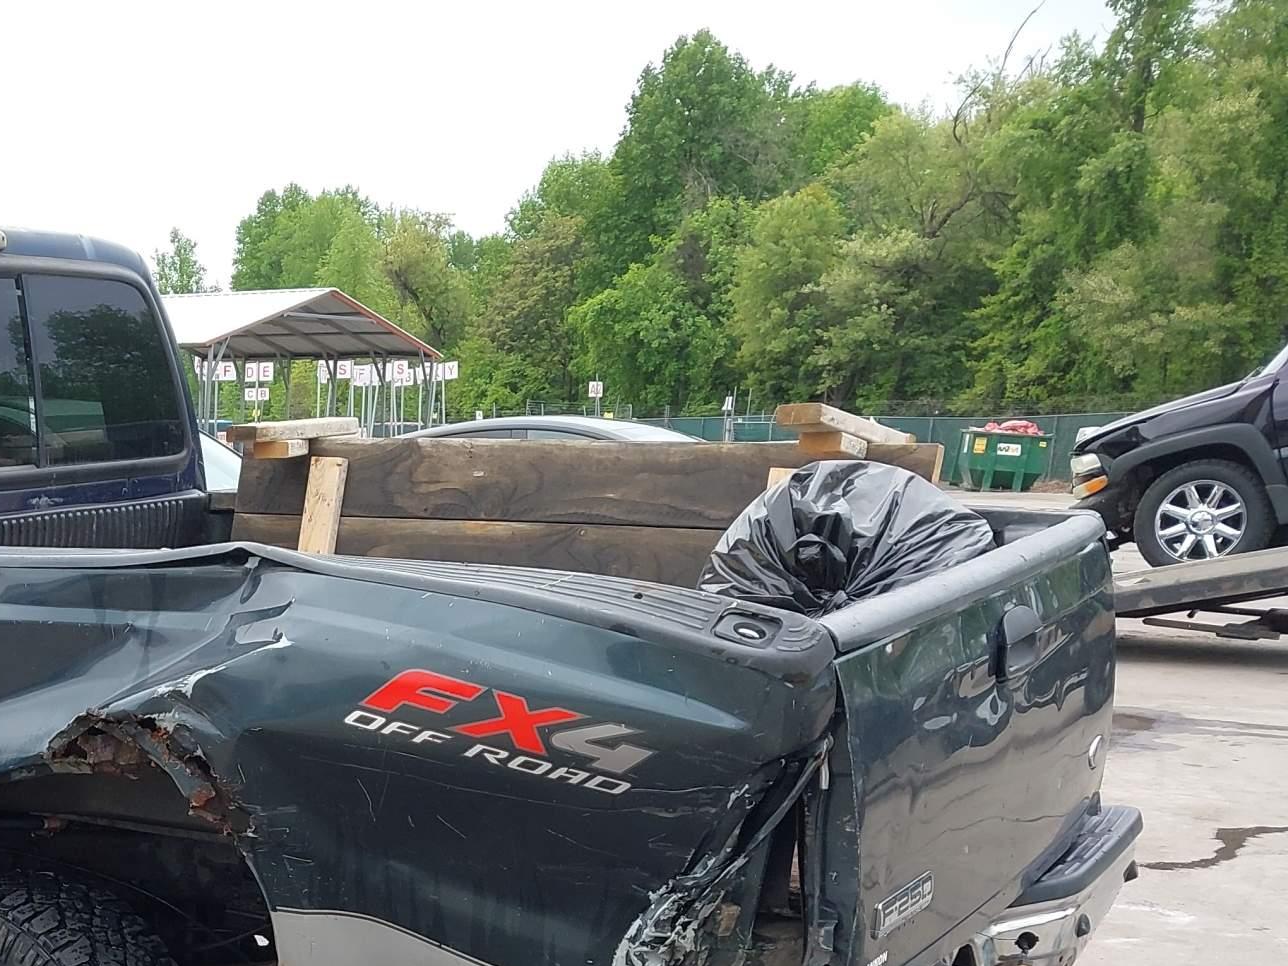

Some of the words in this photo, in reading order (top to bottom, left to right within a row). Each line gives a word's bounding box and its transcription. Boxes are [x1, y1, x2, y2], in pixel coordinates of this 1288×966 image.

[246, 366, 254, 378] D
[262, 366, 270, 377] E
[338, 364, 347, 375] S
[396, 363, 405, 375] S
[448, 364, 455, 375] Y
[359, 668, 659, 775] FX4
[344, 709, 456, 745] OFF
[463, 743, 633, 795] ROAD
